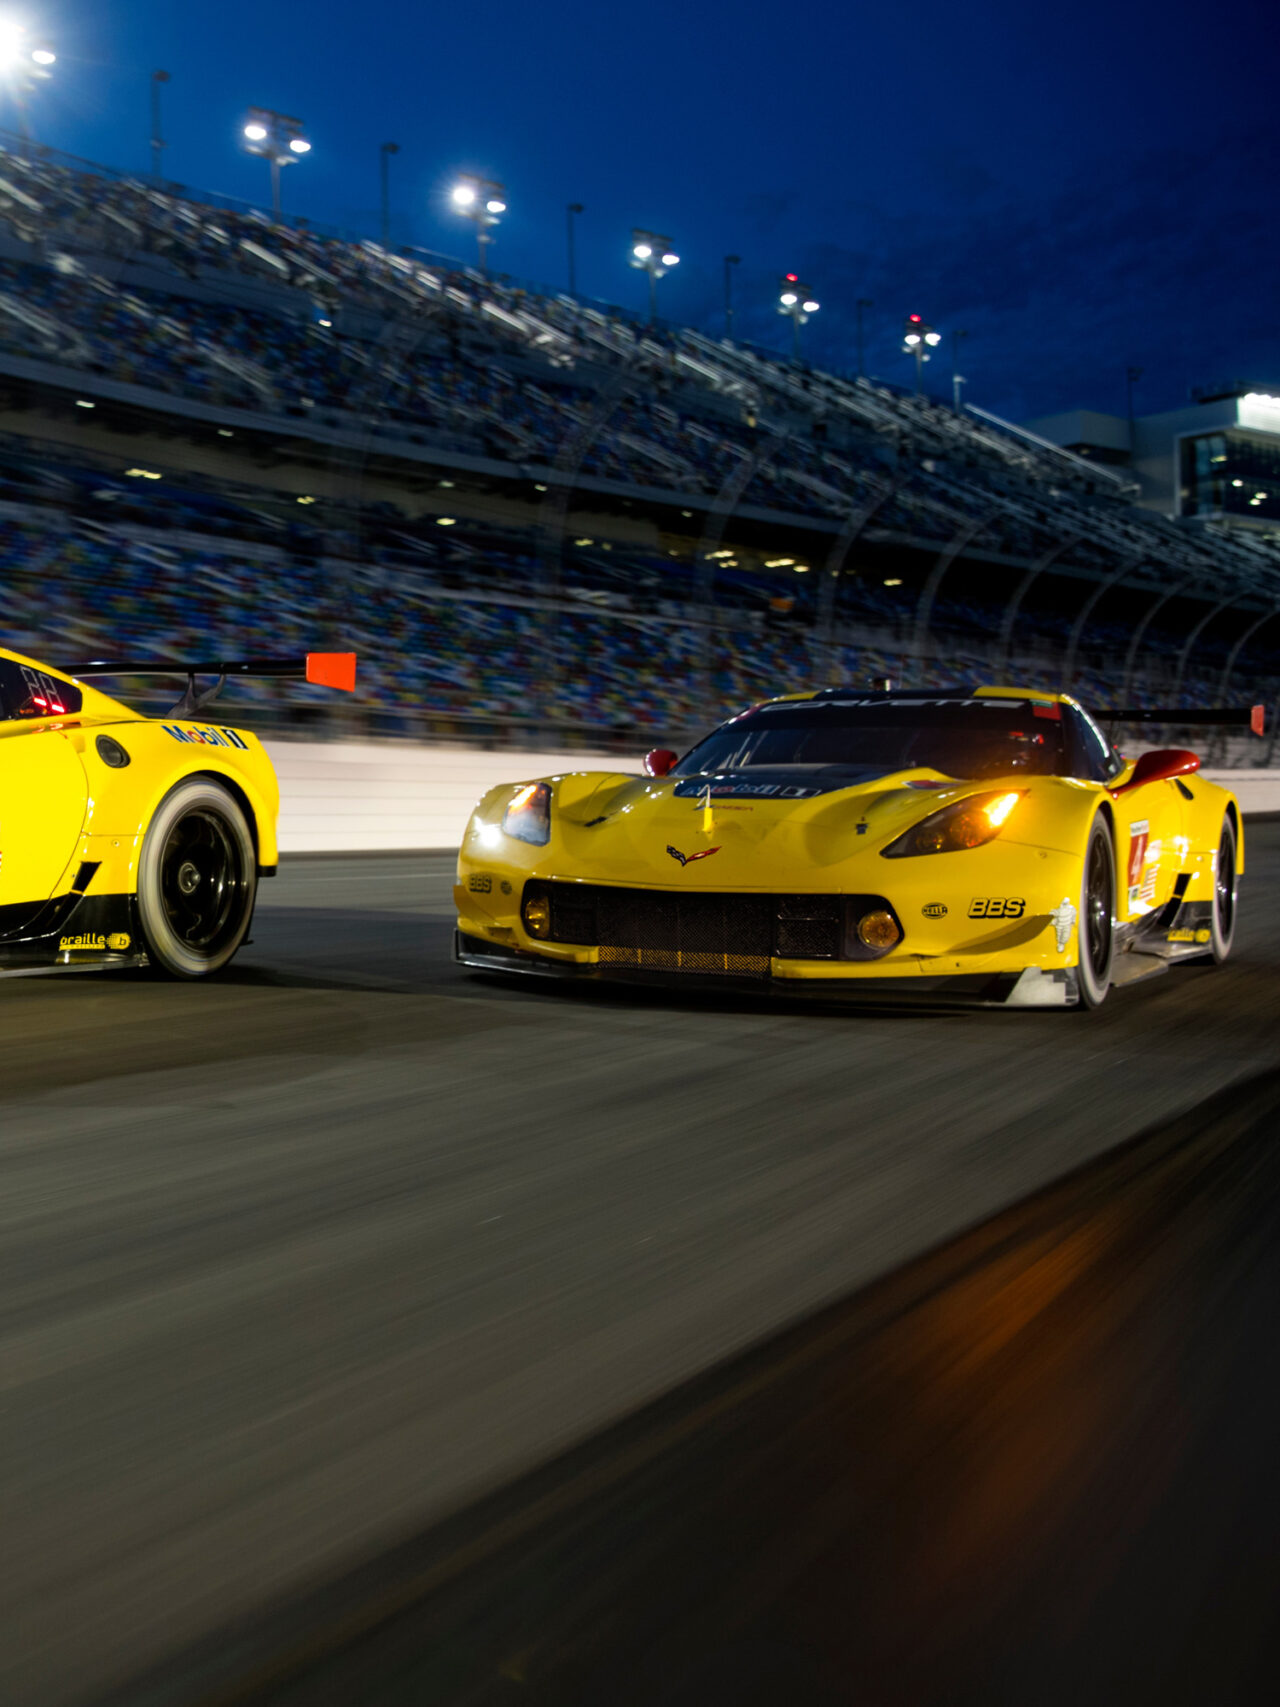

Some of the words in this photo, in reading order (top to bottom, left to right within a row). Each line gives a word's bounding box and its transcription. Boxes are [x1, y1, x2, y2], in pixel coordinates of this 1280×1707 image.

[161, 725, 230, 747] Mobil
[224, 729, 246, 749] 1
[967, 897, 1026, 919] BBS
